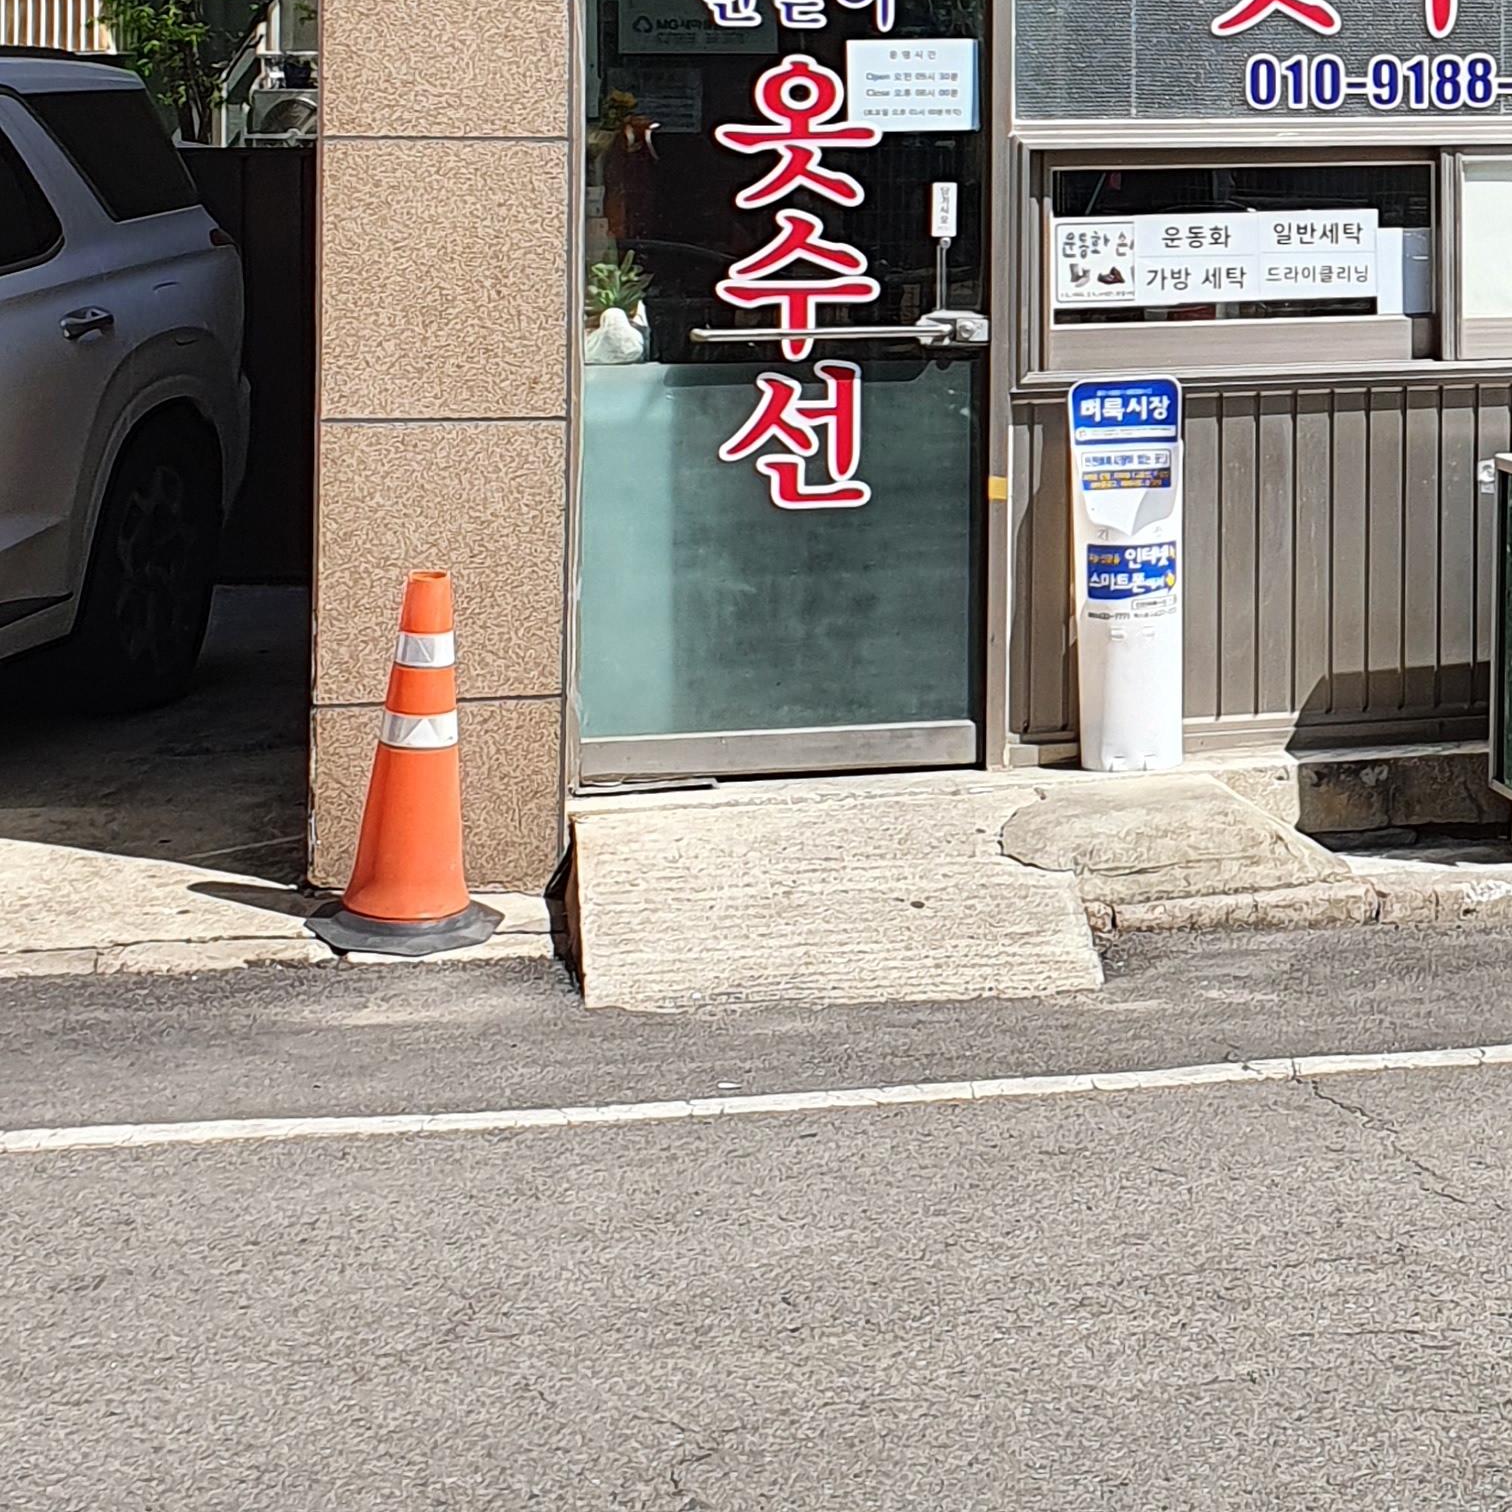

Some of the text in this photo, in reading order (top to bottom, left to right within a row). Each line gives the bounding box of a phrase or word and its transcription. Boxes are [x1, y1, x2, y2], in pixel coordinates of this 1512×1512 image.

[1161, 224, 1233, 249] 운동화
[1273, 221, 1364, 246] 일반세탁
[714, 53, 884, 510] 옷수선
[1146, 265, 1248, 292] 가방 세탁
[1265, 263, 1370, 285] 드라이클리닝
[1080, 395, 1171, 423] 벼룩시장
